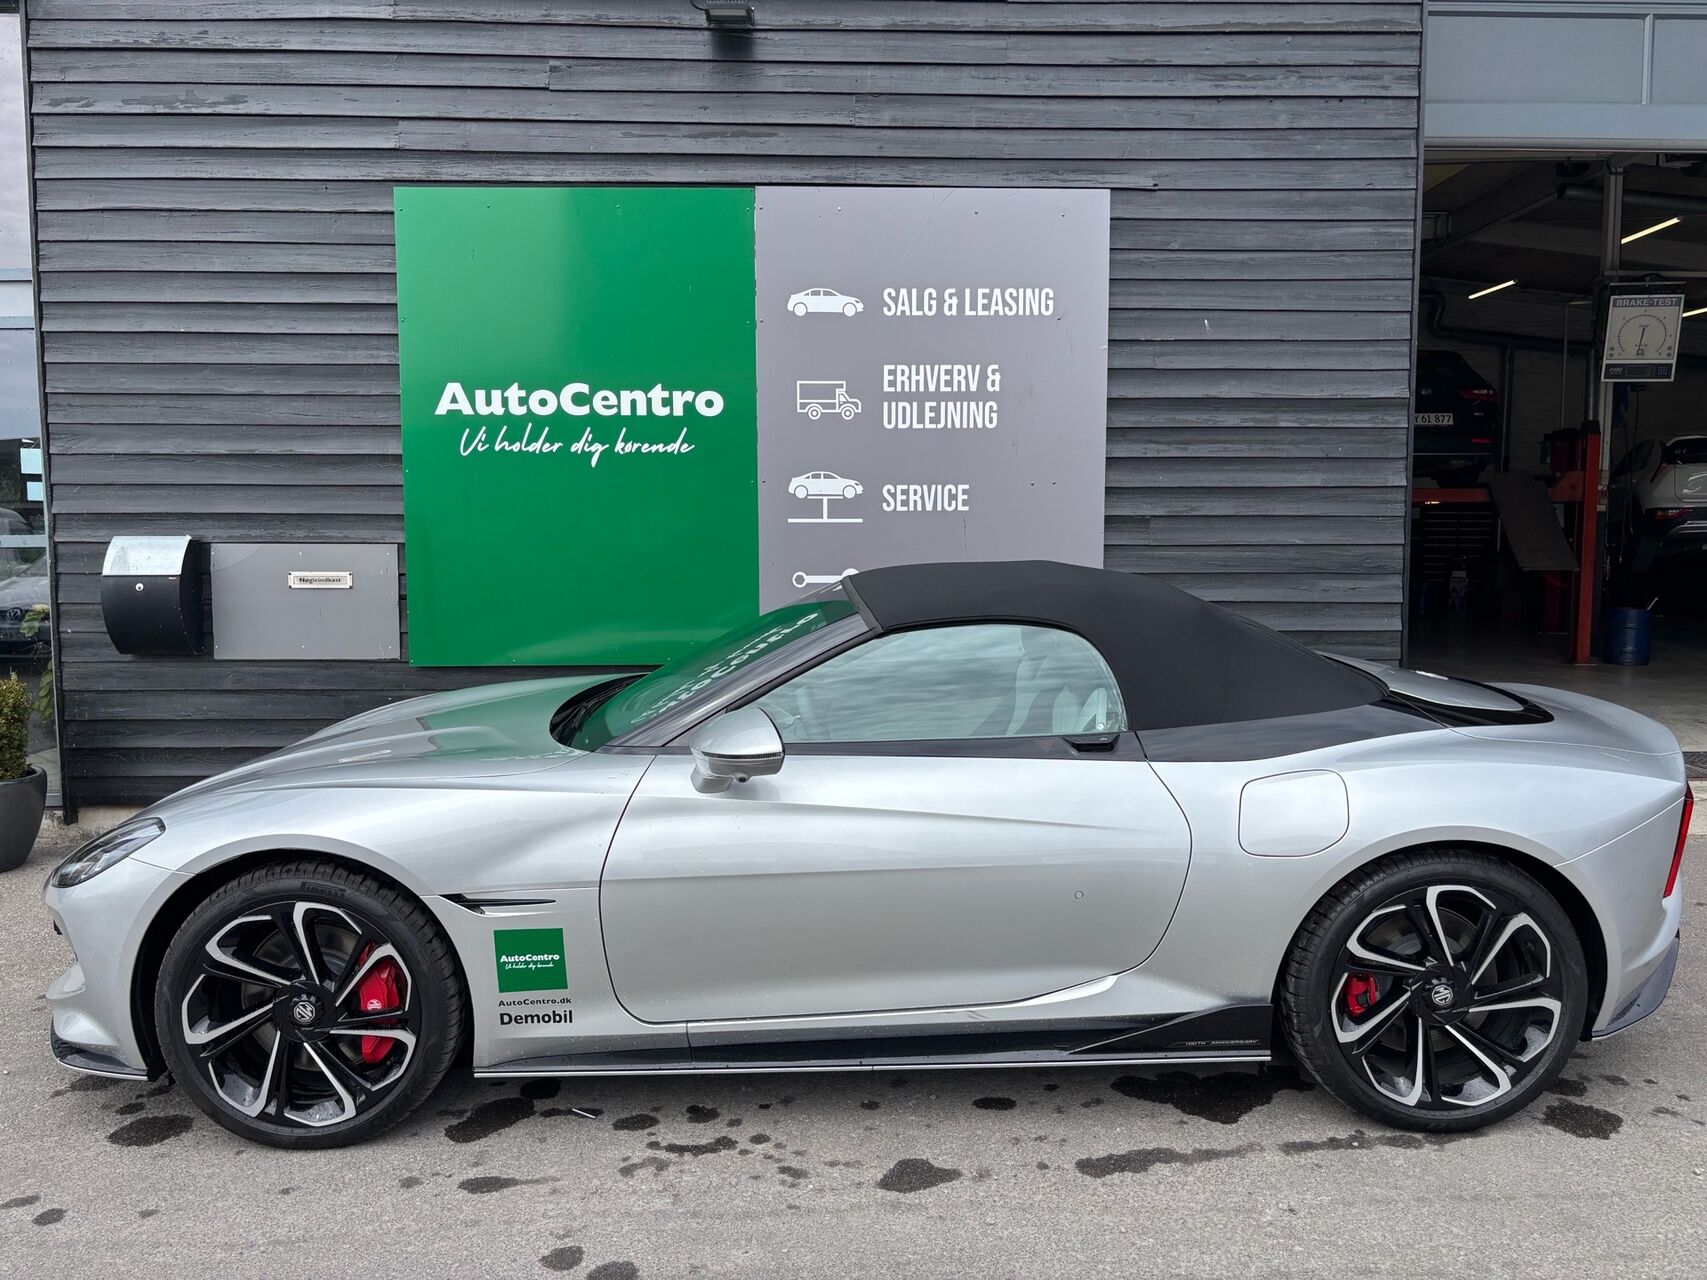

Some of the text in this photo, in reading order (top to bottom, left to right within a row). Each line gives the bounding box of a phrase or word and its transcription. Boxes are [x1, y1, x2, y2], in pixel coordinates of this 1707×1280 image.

[882, 287, 1055, 317] SALG & LEASING
[882, 364, 1002, 392] ERHVERV &
[434, 382, 724, 417] AutoCentro
[882, 401, 998, 430] UDLEJNING
[1421, 414, 1431, 423] 61
[1434, 414, 1451, 423] 877
[459, 422, 696, 468] Vi holder dig kørende
[882, 484, 970, 512] SERVICE
[500, 954, 560, 962] AutoCentro
[498, 997, 572, 1007] AutoCentro.dk
[500, 1010, 573, 1026] Demobil
